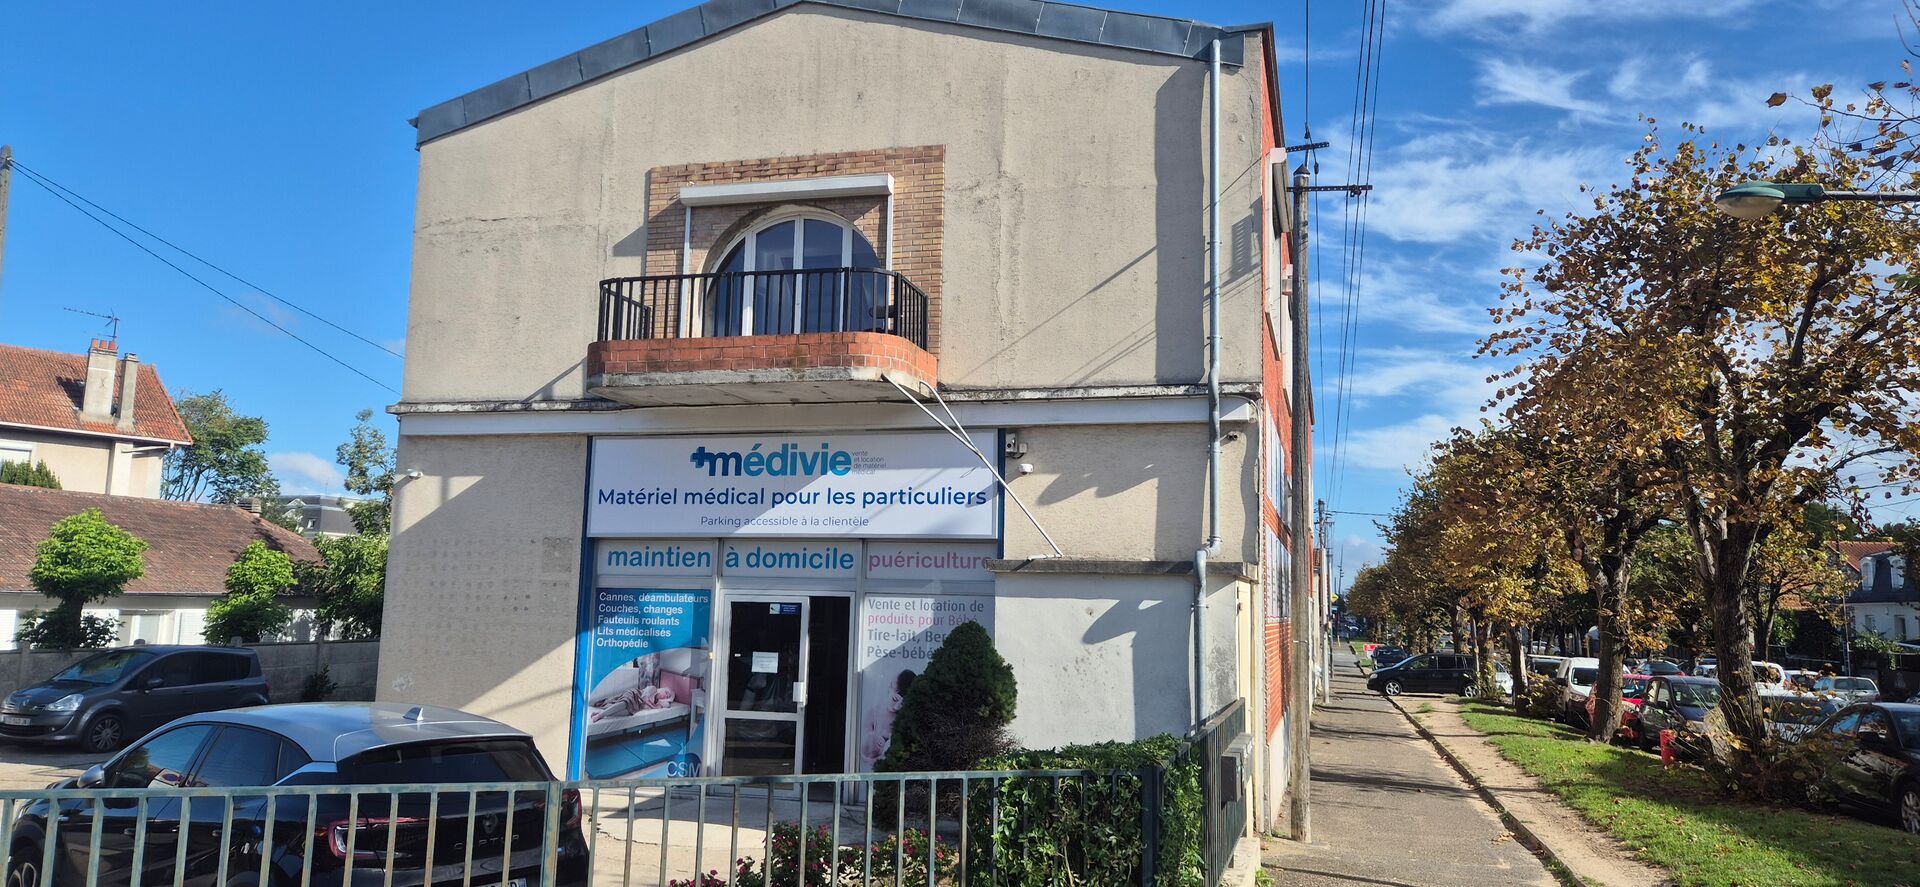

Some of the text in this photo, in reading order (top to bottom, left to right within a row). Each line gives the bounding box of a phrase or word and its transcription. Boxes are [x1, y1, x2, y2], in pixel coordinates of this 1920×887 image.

[707, 442, 852, 477] médivie
[598, 486, 988, 509] Matériel médical pour les particuliers
[701, 516, 870, 528] Parking accessible à la clientèle
[607, 545, 855, 570] maintien à domicile
[599, 592, 709, 603] Cannes, déambulateurs
[598, 603, 684, 616] Couches, changes
[867, 598, 985, 613] Vente et location de
[598, 614, 680, 626] Fauteuils roulants
[867, 612, 914, 627] produits
[918, 615, 945, 628] pour
[597, 626, 672, 637] Lits médicalisés
[867, 628, 920, 644] Tire-lait,
[596, 638, 649, 649] Orthopédie
[667, 760, 702, 778] CSM
[454, 833, 520, 850] CPTR
